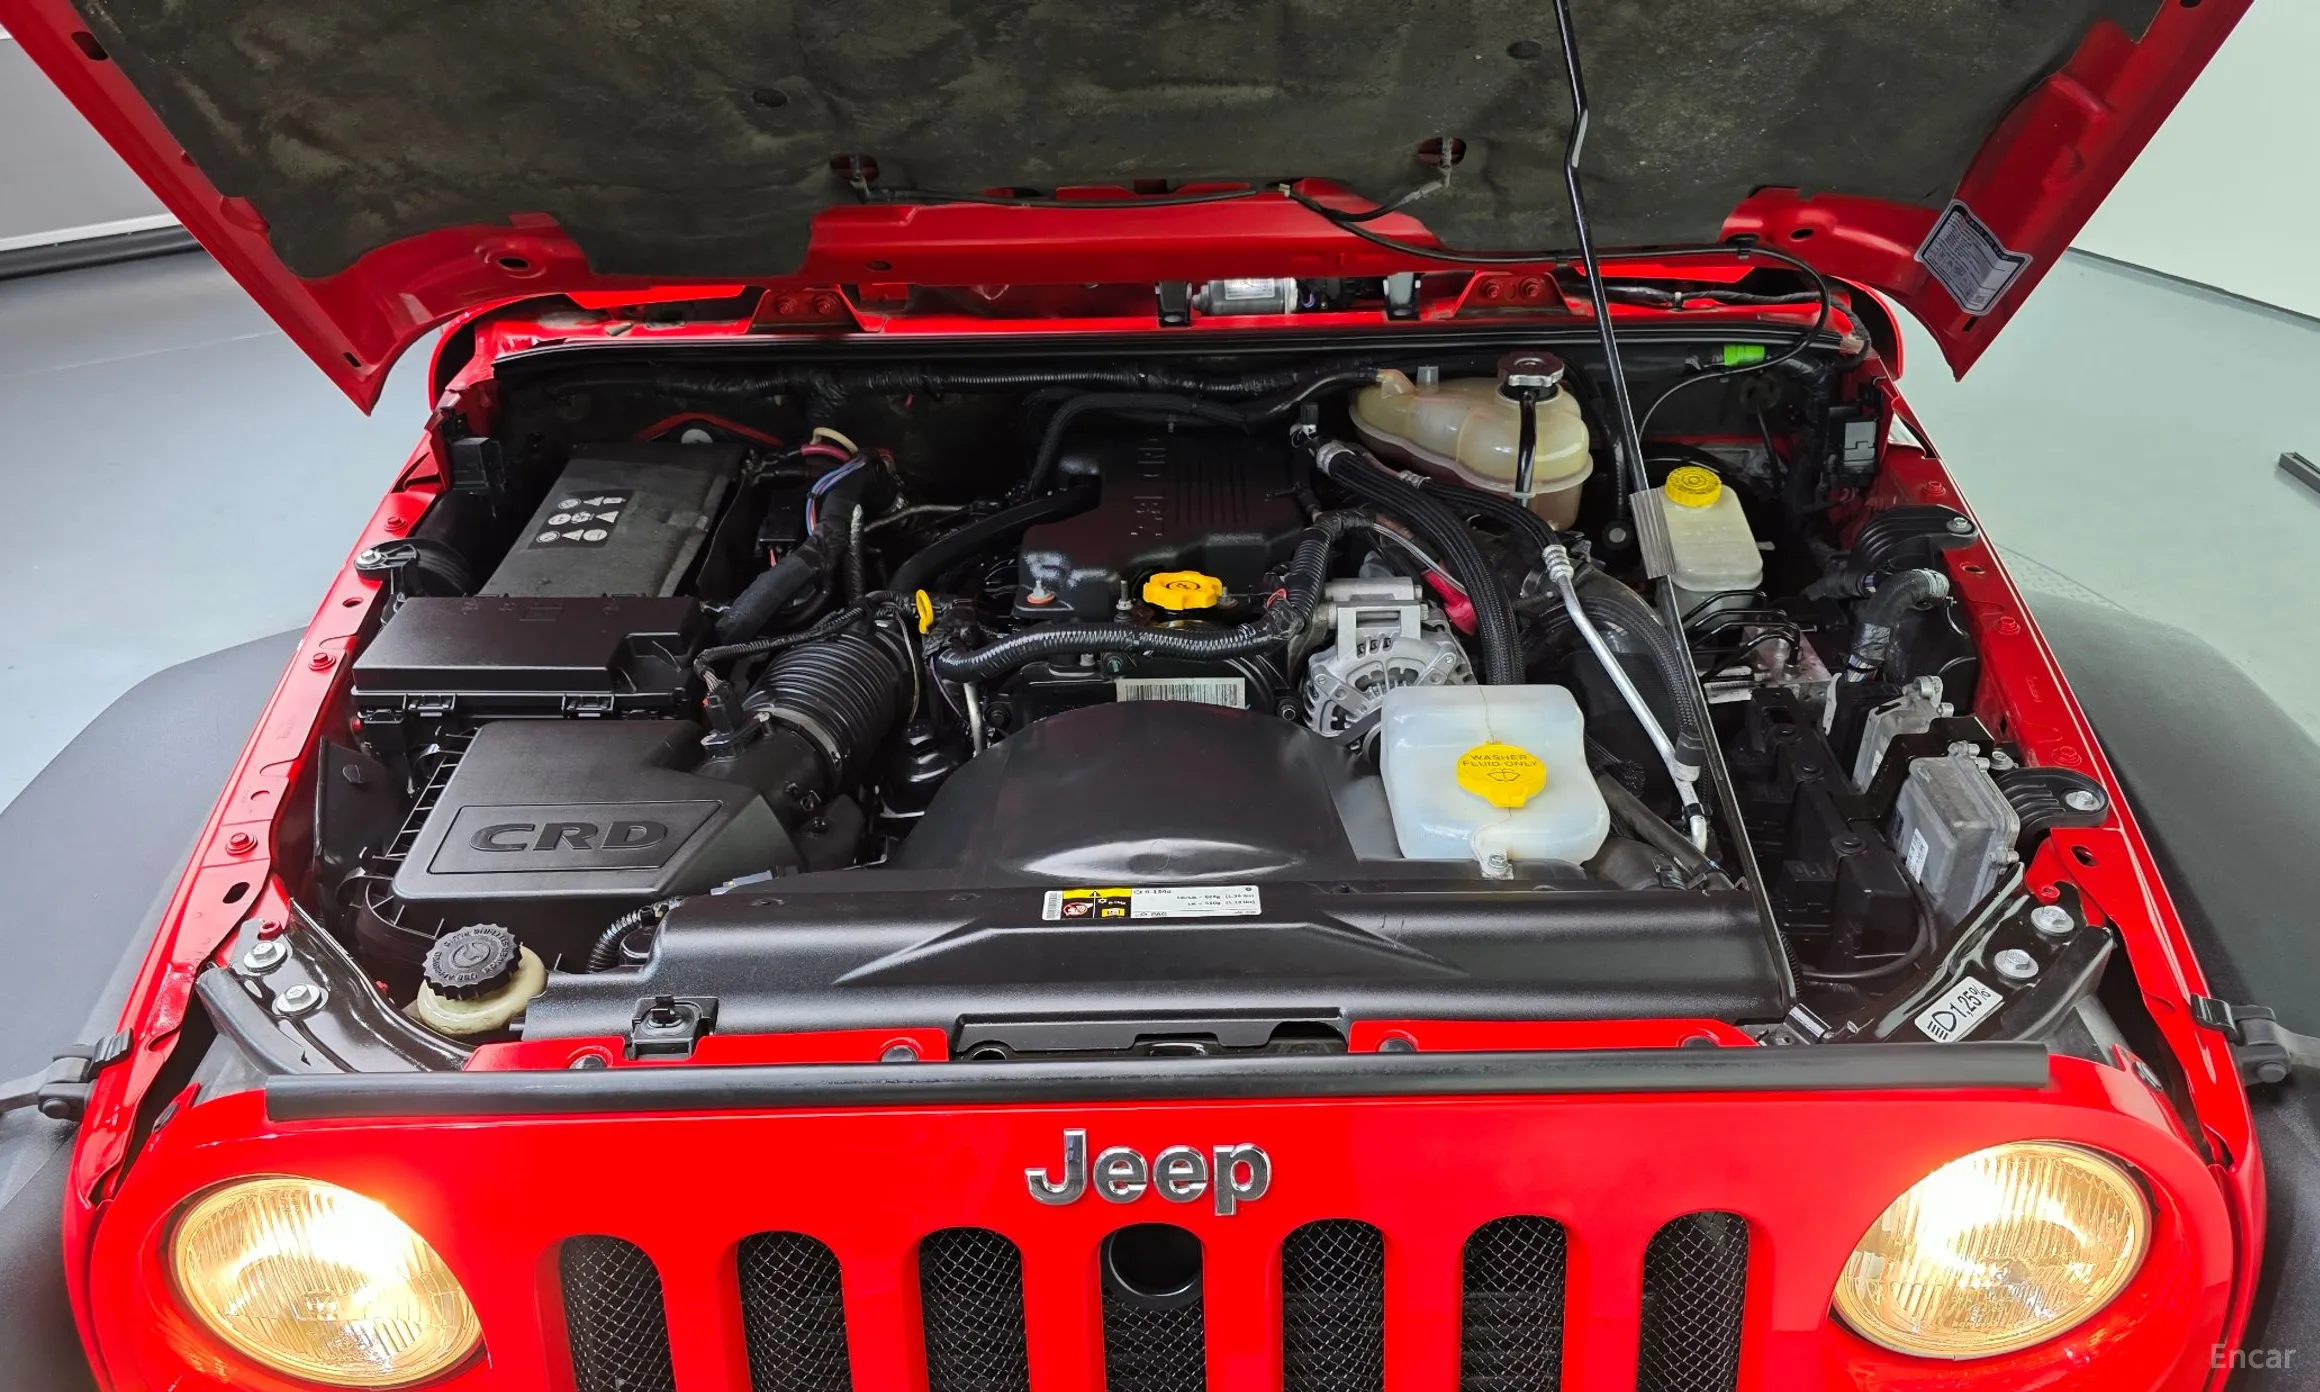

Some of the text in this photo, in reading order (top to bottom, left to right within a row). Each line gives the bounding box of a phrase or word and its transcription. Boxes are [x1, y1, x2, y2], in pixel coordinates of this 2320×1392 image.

[469, 820, 668, 852] CRD
[1950, 984, 1991, 1018] 1,25%
[1024, 1128, 1272, 1216] Jeep
